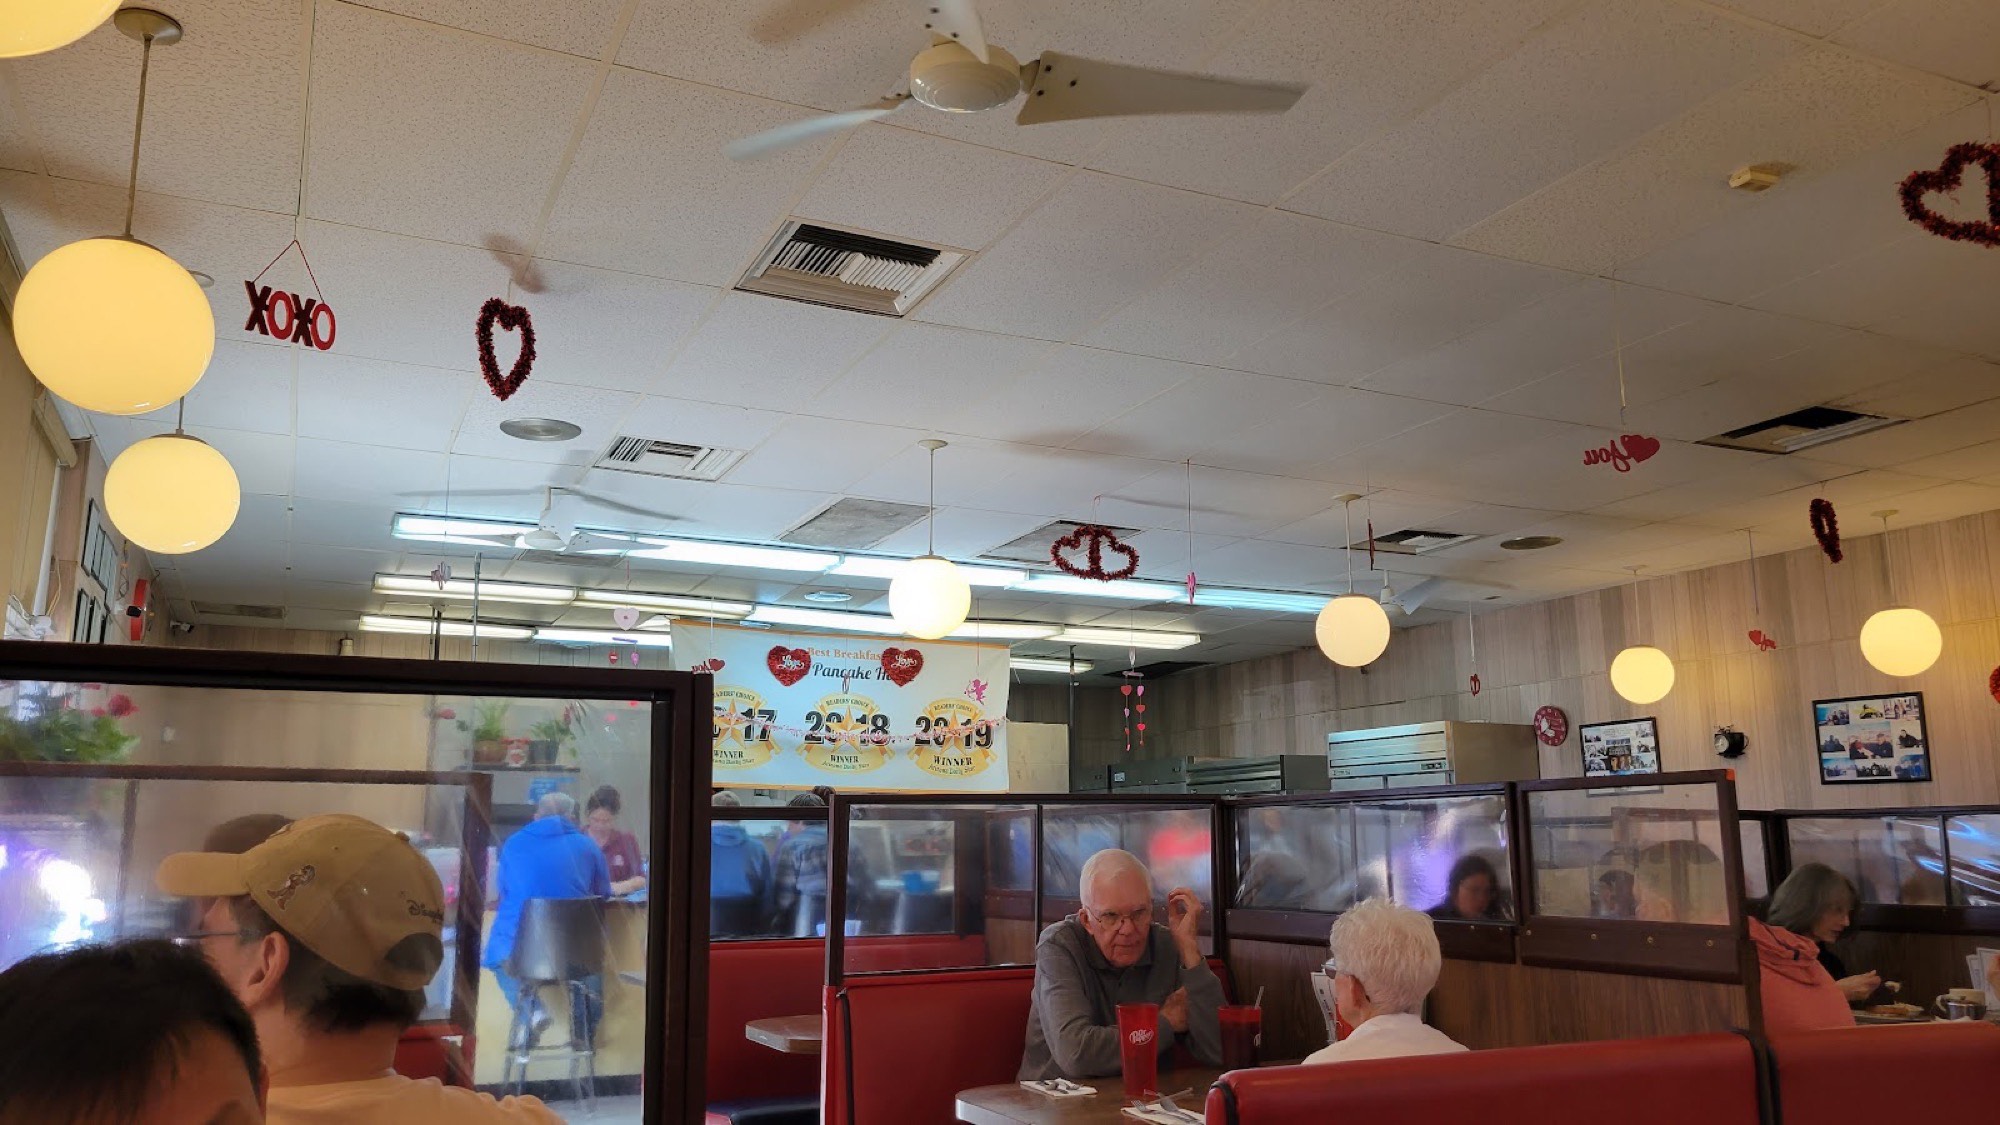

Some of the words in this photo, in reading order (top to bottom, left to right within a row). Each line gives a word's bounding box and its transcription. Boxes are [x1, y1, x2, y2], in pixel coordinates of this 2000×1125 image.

[244, 280, 336, 350] XOXO
[807, 647, 830, 657] Best
[834, 648, 883, 660] Breakfas
[812, 662, 872, 680] Pancake
[804, 710, 891, 747] 2018
[914, 715, 994, 749] 2019
[830, 754, 859, 763] WINNER
[933, 755, 972, 766] WINNER
